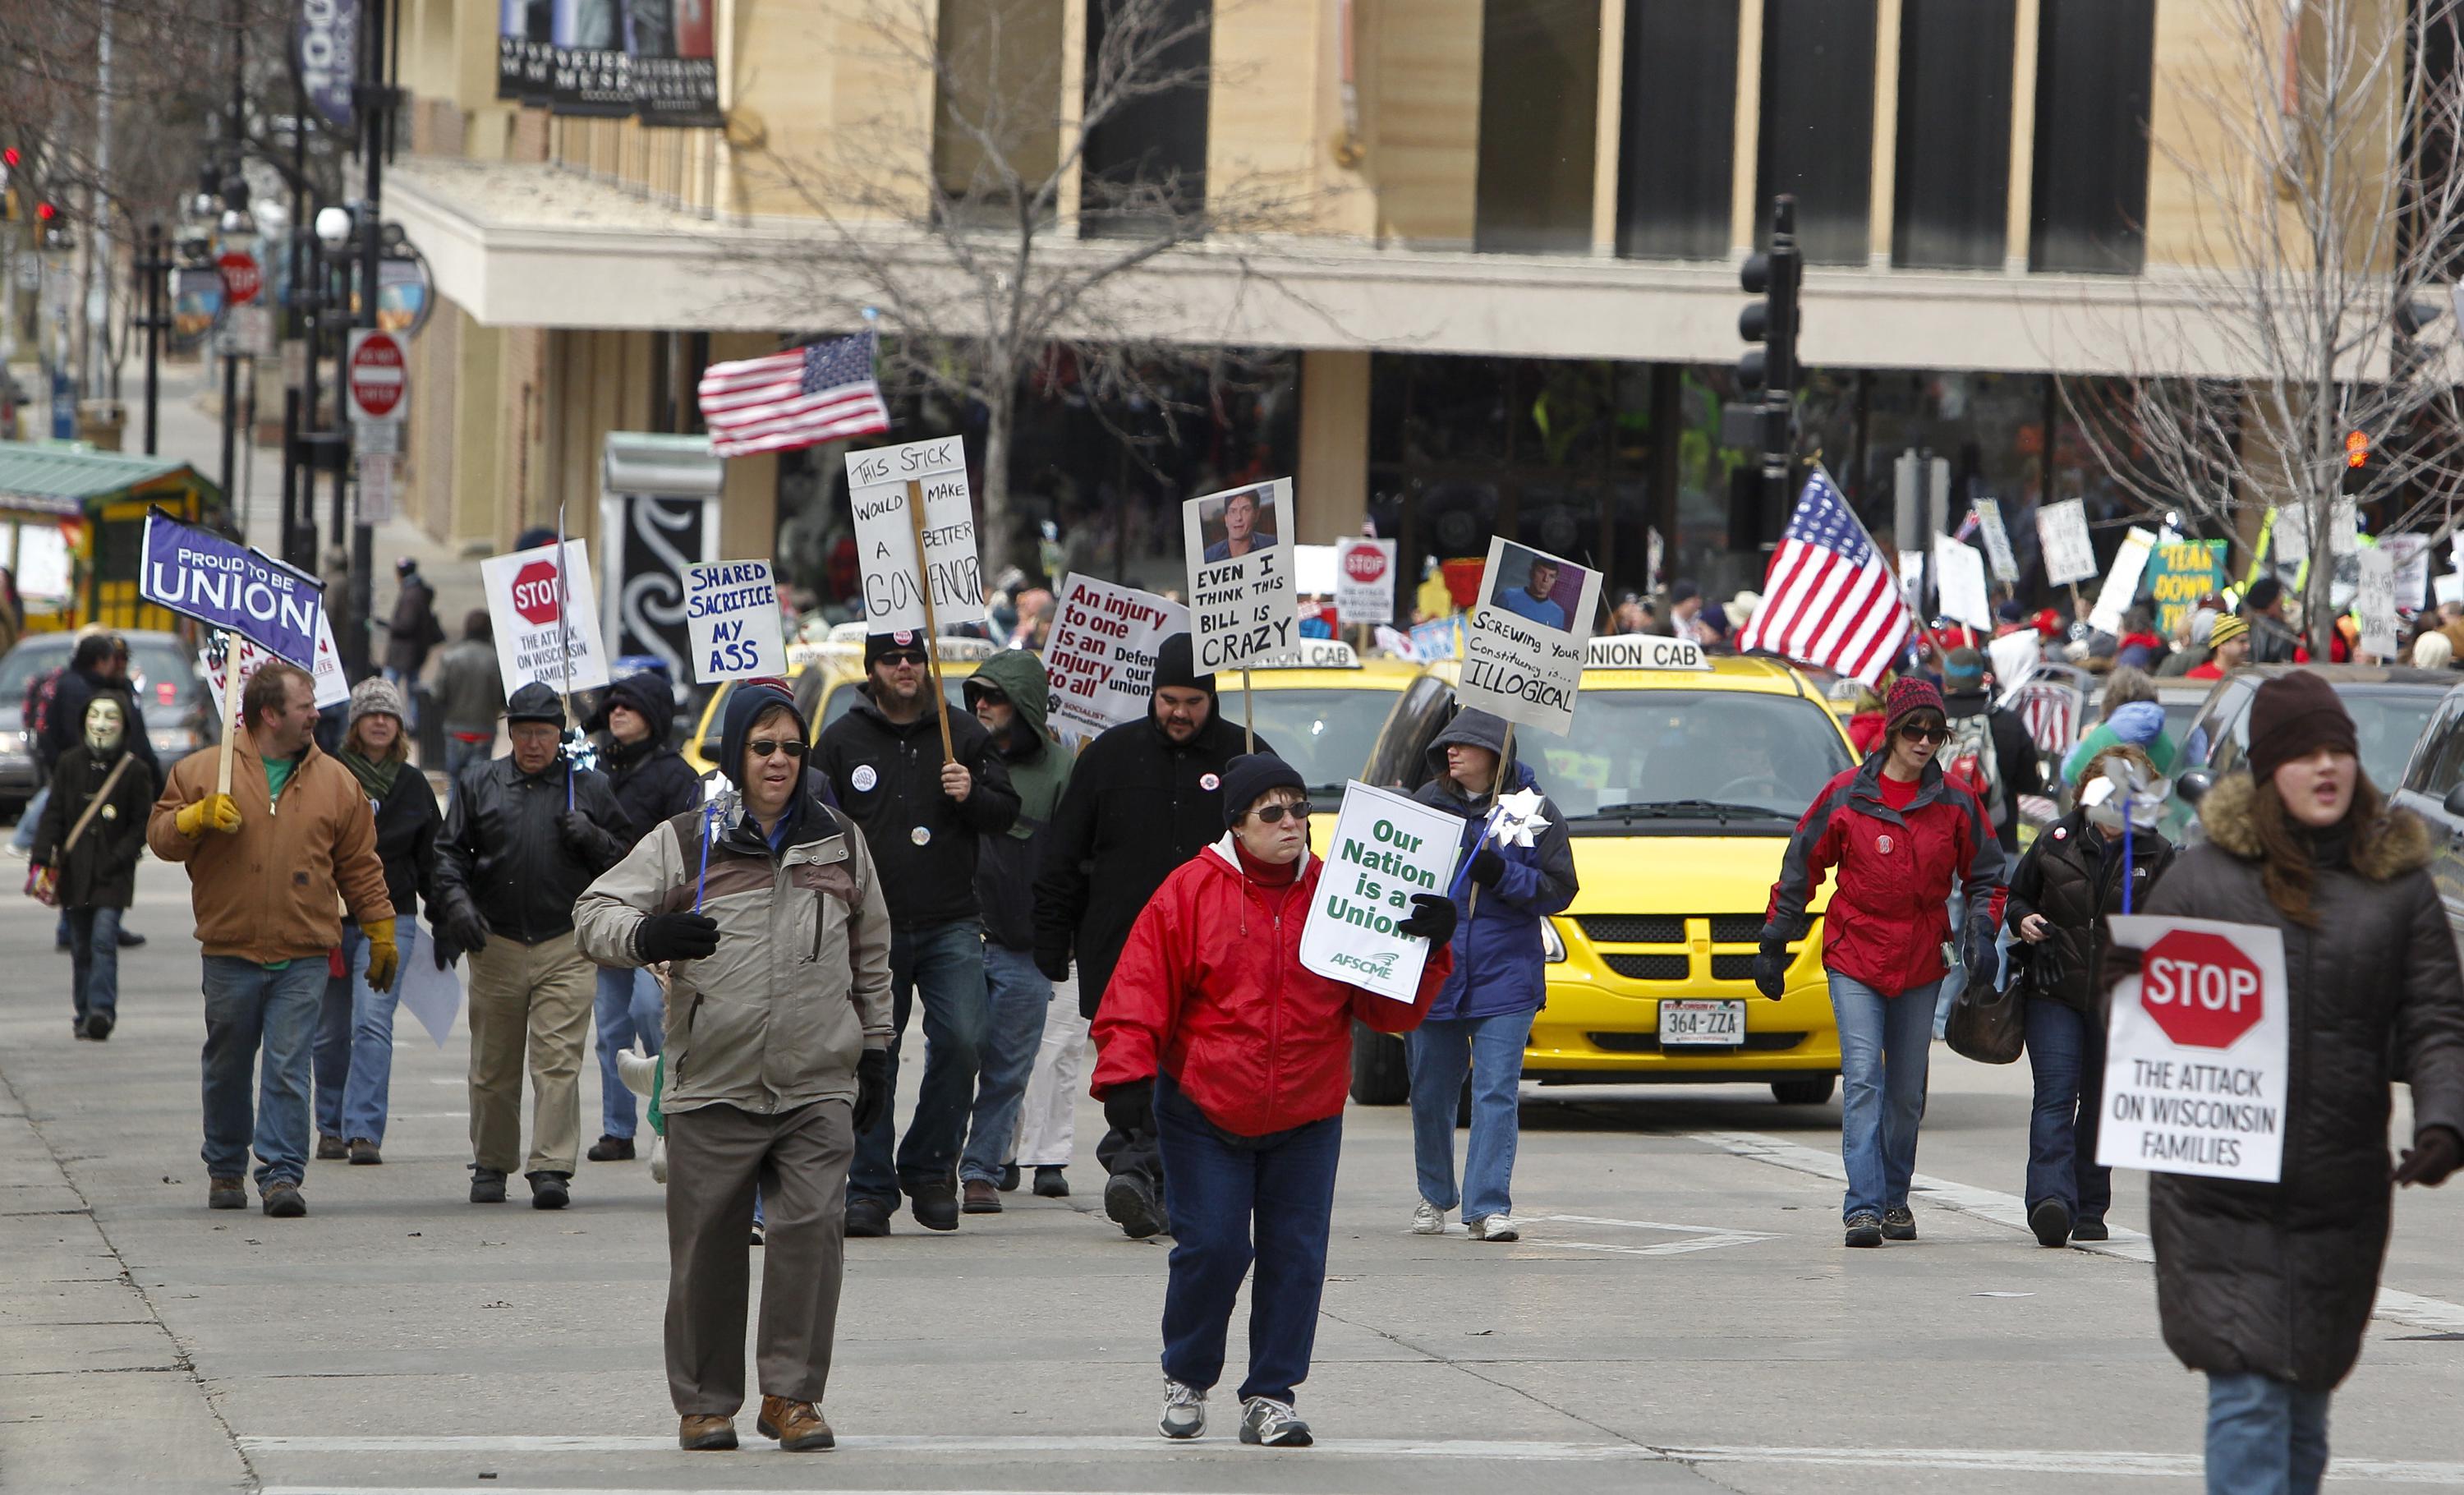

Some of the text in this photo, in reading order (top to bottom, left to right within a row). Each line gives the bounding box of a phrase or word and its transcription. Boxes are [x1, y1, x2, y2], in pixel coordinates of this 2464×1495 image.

[851, 443, 952, 485] THIS STICK
[854, 484, 965, 521] WOULD MAKE
[876, 521, 972, 559] A BETTER
[178, 547, 295, 592] PROUD TO BE
[690, 564, 766, 591] SHARED
[1198, 554, 1274, 589] EVEN I
[1346, 555, 1383, 573] STOP
[153, 562, 315, 638] UNION
[687, 585, 775, 618] SACRIFICE
[866, 555, 984, 616] GOVENOR
[1195, 576, 1284, 606] THINK THIS
[1064, 603, 1129, 638] to one
[1069, 583, 1168, 631] An injury
[1201, 605, 1270, 633] BILL IS
[521, 625, 578, 651] THE ATTK
[712, 619, 743, 643] MY
[1056, 623, 1106, 656] is an
[1202, 616, 1292, 666] CRAZY
[517, 653, 531, 669] ON
[709, 640, 759, 673] ASS
[1050, 644, 1114, 684] injury
[1115, 646, 1157, 667] Defen
[1312, 646, 1349, 664] CAB
[1469, 637, 1541, 678] Constituency
[1654, 643, 1697, 665] CAB
[1046, 666, 1098, 698] to all
[1109, 679, 1153, 697] union
[1126, 667, 1152, 681] our
[1465, 658, 1572, 713] ILLOGICAL
[1372, 820, 1423, 853] Our
[1341, 838, 1436, 890] Nation
[1355, 872, 1407, 909] is a
[1331, 953, 1394, 980] AFSCME
[2145, 955, 2258, 1013] STOP
[1668, 1013, 1735, 1033] 364-ZZA
[2134, 1059, 2264, 1098] THE ATTACK
[2113, 1093, 2277, 1135] ON WISCONSIN
[2141, 1130, 2241, 1167] FAMILIES
